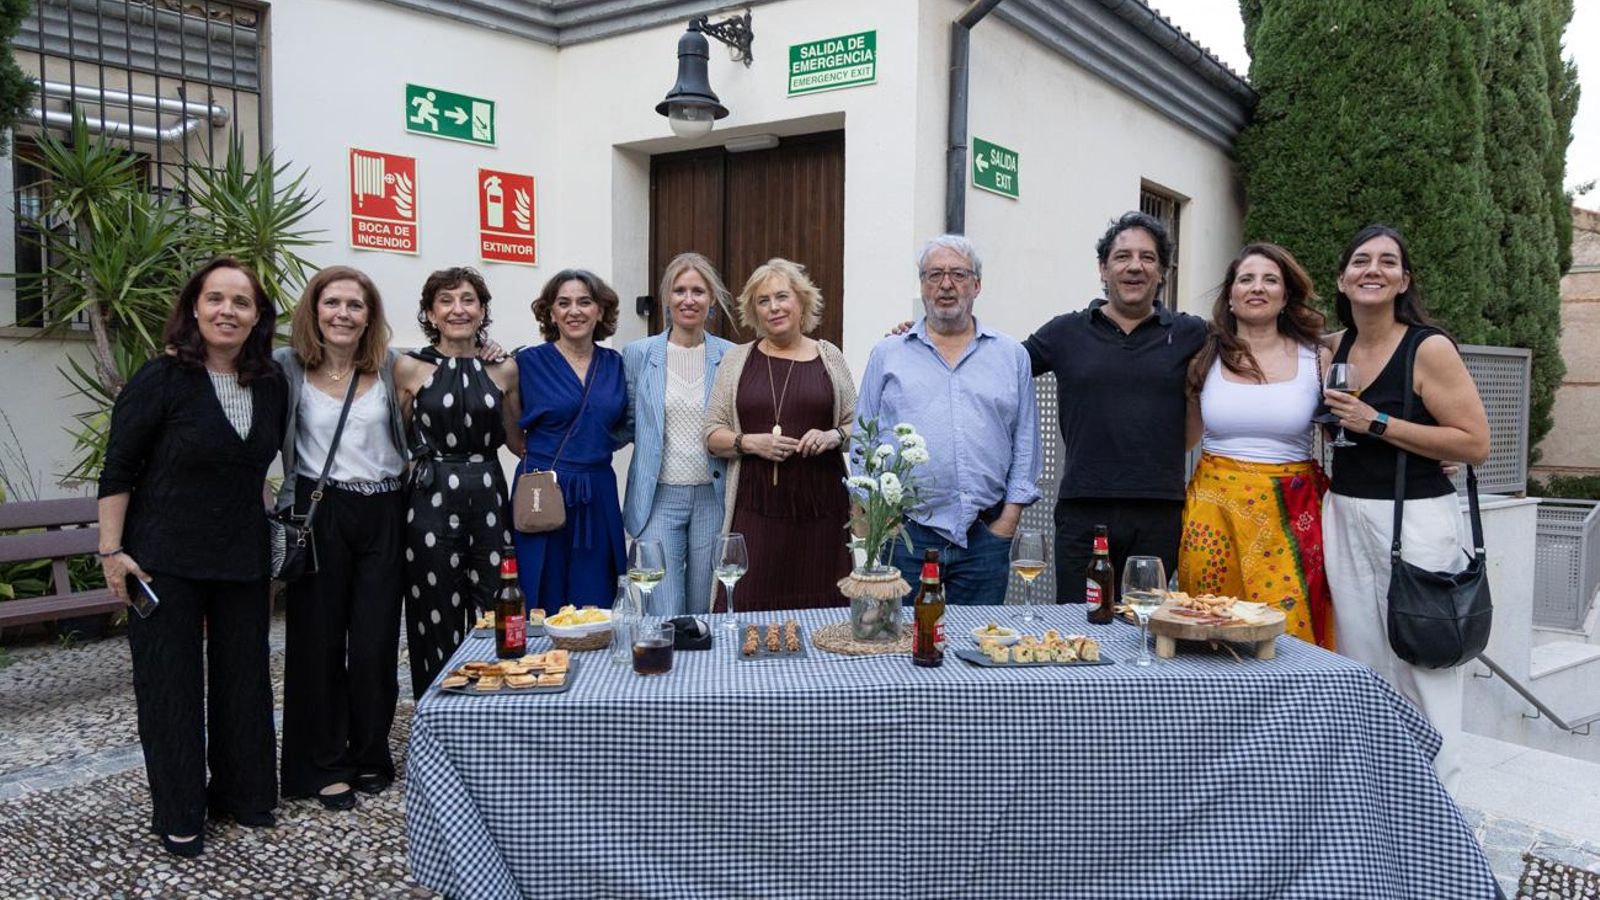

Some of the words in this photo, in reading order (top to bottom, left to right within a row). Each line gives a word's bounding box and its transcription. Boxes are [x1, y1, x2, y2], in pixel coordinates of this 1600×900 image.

[800, 41, 844, 59] SALIDA
[848, 36, 865, 50] DE
[793, 49, 873, 73] EMERGENCIA
[793, 70, 848, 87] EMERGENCY
[851, 67, 871, 78] EXIT
[990, 149, 1016, 172] SALIDA
[996, 172, 1011, 191] EXIT
[358, 221, 390, 235] BOCA
[394, 226, 410, 237] DE
[358, 234, 411, 249] INCENDIO
[483, 241, 533, 255] EXTINTOR
